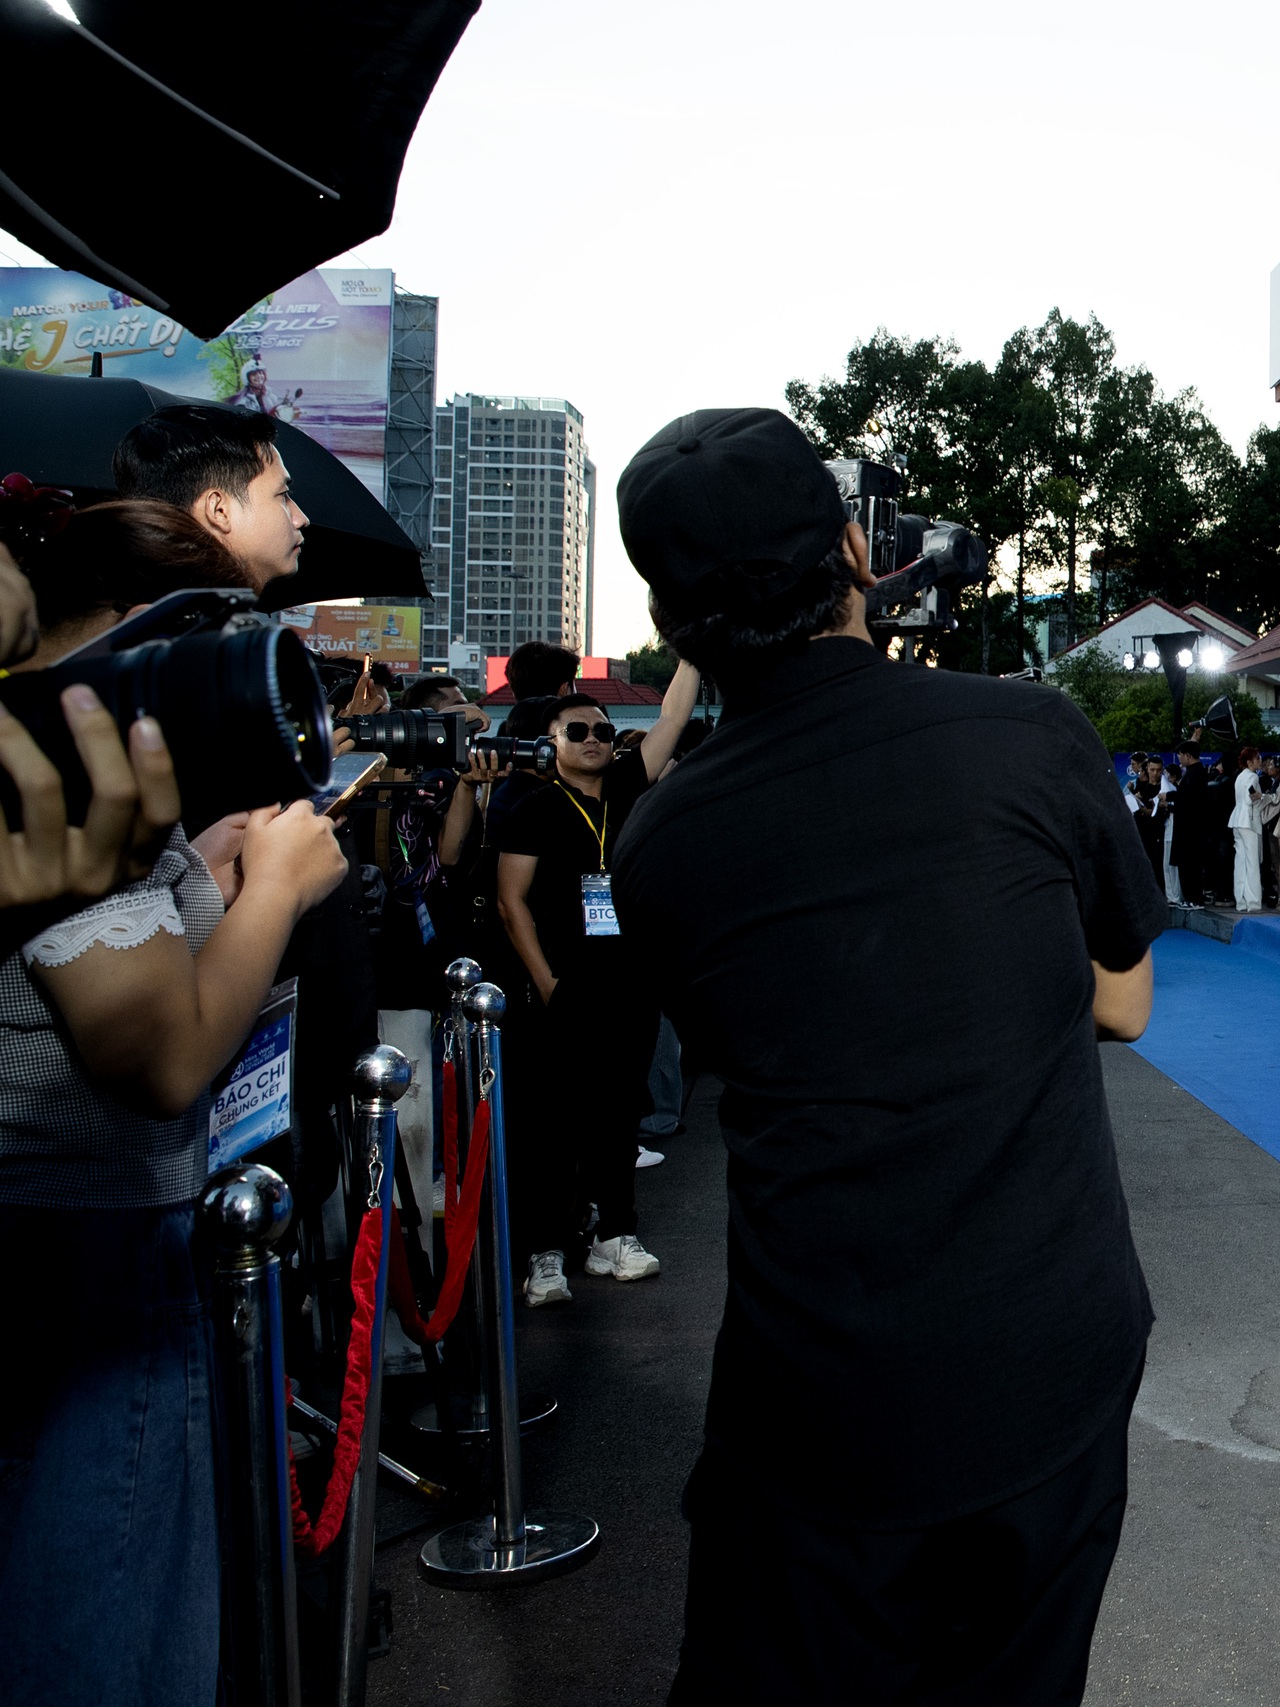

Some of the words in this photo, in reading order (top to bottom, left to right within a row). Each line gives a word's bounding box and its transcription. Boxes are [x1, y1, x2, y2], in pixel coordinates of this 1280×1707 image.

[13, 303, 65, 317] MATCH
[69, 300, 109, 313] YOUR
[254, 305, 283, 314] ALL
[285, 303, 321, 314] NEW
[225, 316, 340, 333] anus
[24, 319, 68, 371] J
[74, 314, 148, 348] CHẤT
[320, 637, 356, 652] XUẤT
[589, 908, 615, 919] BTC
[214, 1082, 251, 1115] BÁO
[256, 1056, 286, 1089] CHÍ
[219, 1095, 258, 1126] CHUNG
[262, 1082, 281, 1103] KẾT
